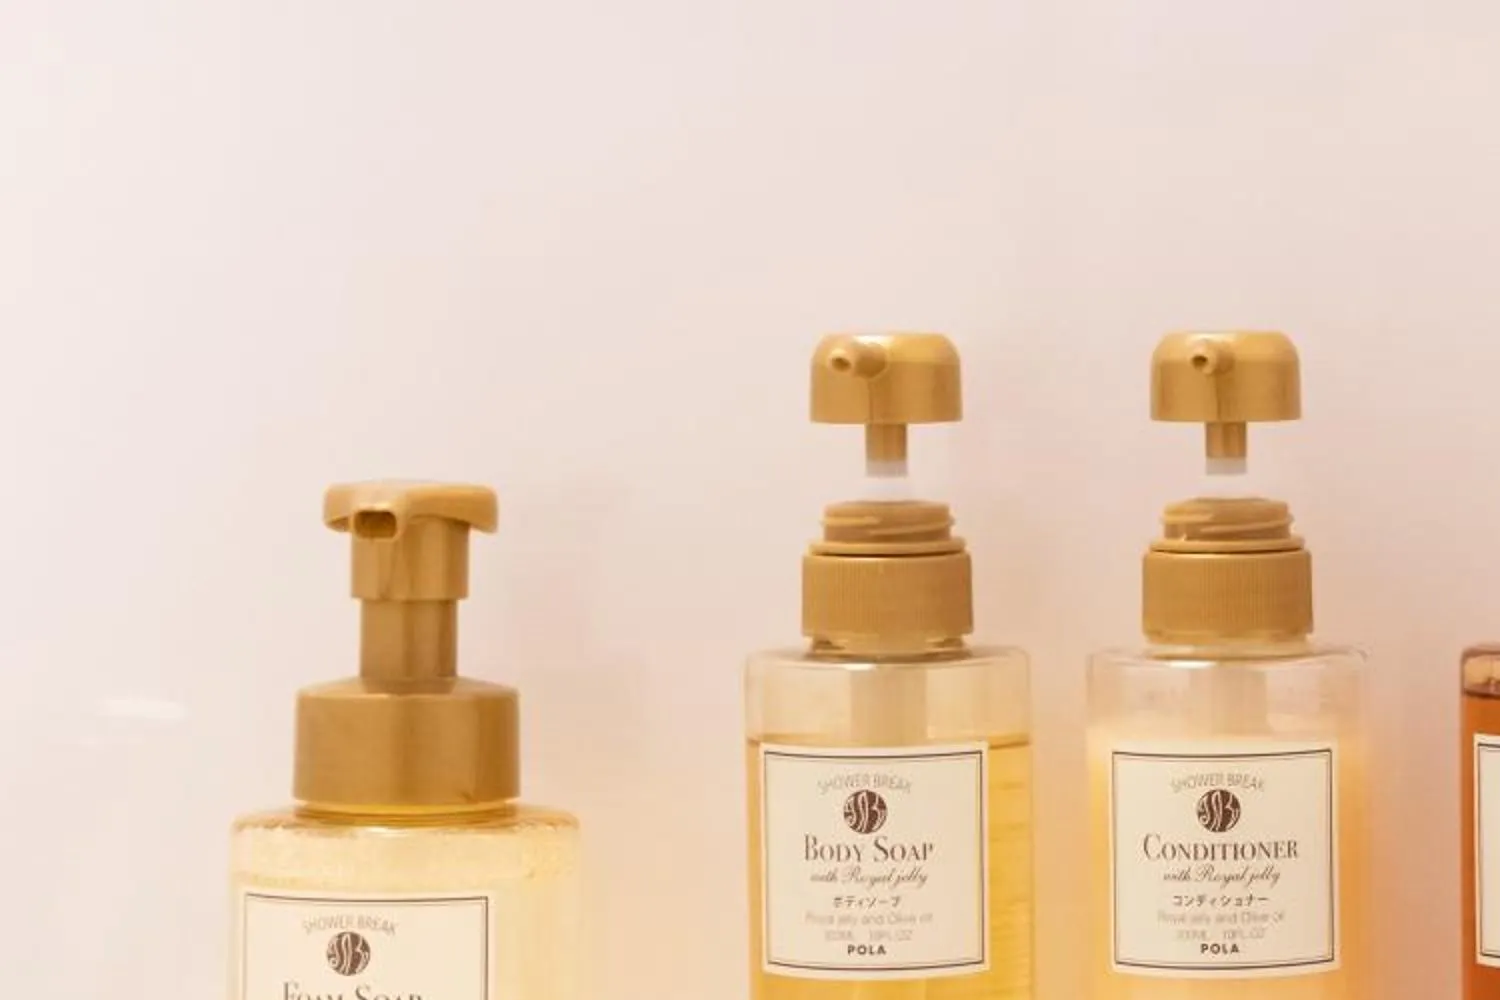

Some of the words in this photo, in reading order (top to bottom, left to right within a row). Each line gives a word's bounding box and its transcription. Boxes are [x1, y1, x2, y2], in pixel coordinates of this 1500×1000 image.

[1142, 833, 1300, 862] CONDITIONER
[810, 868, 838, 883] with
[841, 866, 895, 888] Royal
[893, 866, 928, 888] jelly
[1163, 866, 1191, 882] with
[1194, 864, 1249, 889] Royal
[1245, 865, 1280, 888] jelly
[847, 944, 887, 955] POLA
[1200, 943, 1239, 955] POLA
